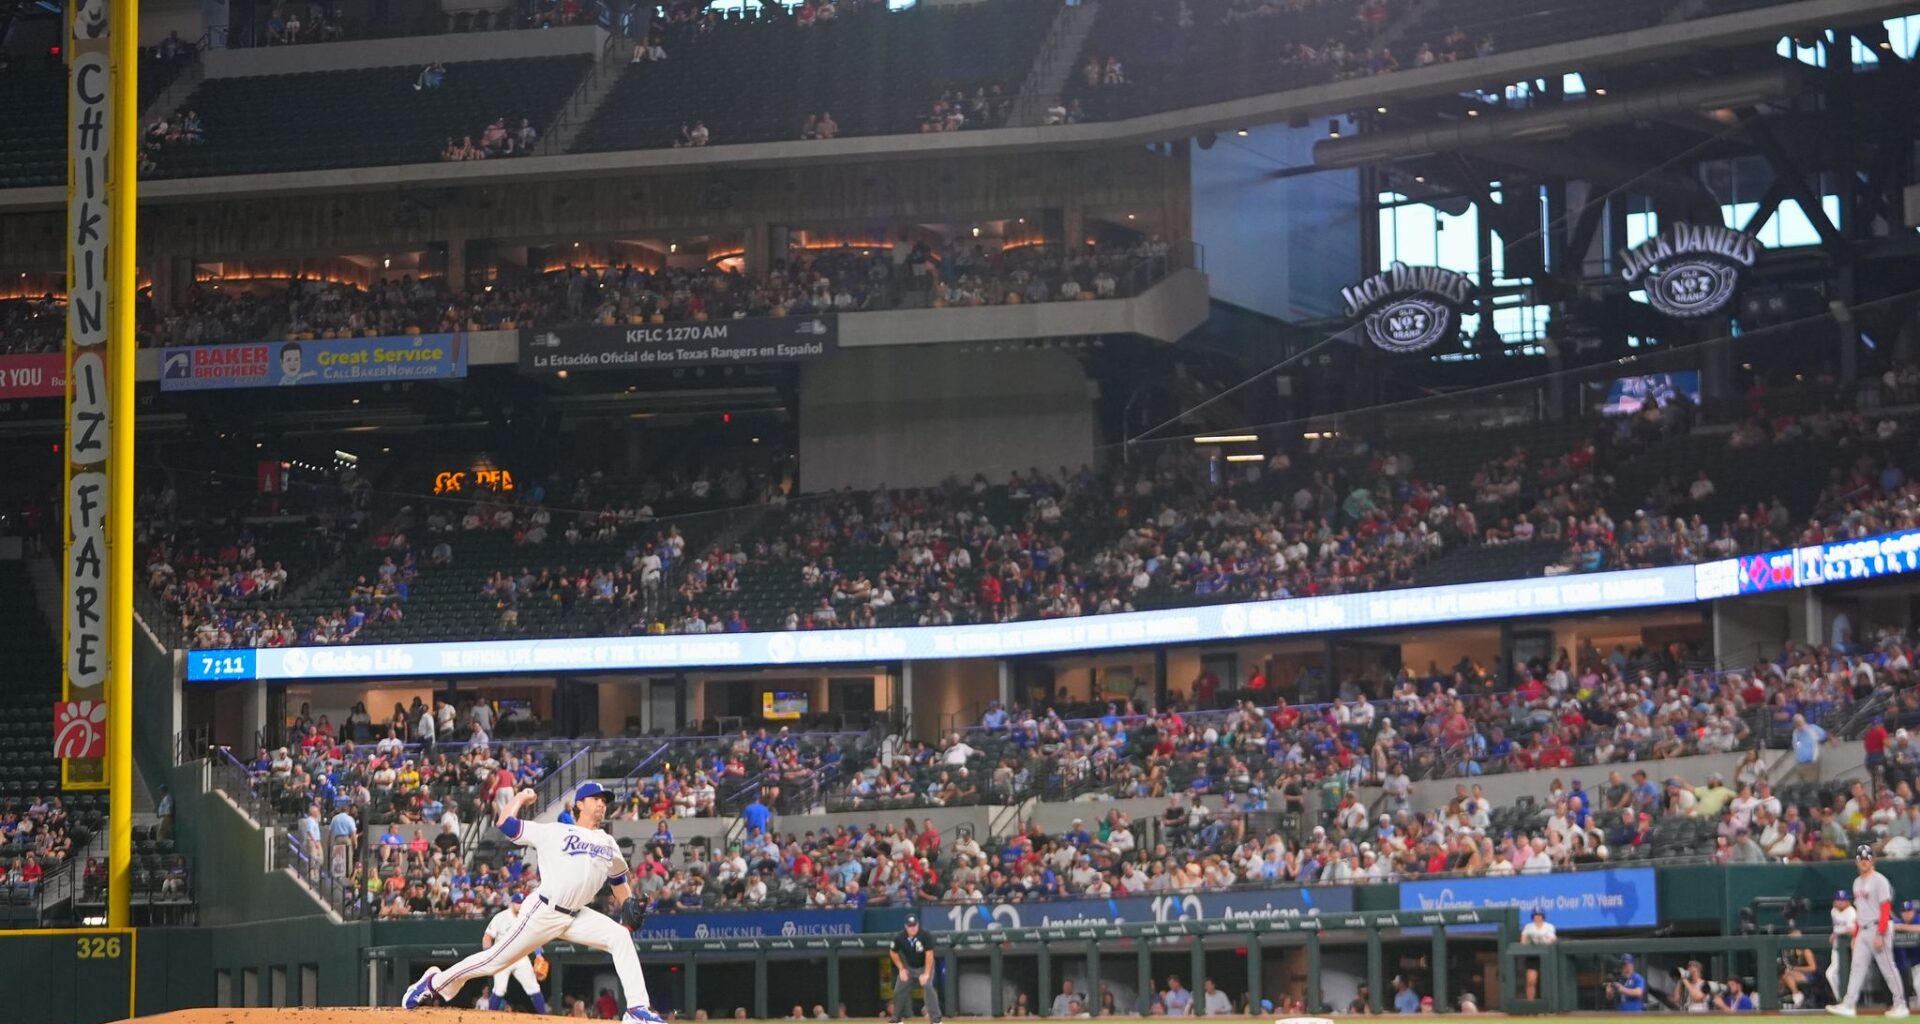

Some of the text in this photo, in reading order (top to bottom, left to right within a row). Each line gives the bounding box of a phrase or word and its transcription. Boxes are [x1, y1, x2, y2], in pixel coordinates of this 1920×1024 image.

[1620, 232, 1672, 281] JACK
[1341, 272, 1390, 318] JACK
[626, 325, 727, 344] KFLC 1270 AM
[195, 346, 269, 366] BAKER
[317, 347, 443, 366] Great Service
[534, 342, 823, 367] La Estación Oficial de los Texas Rangers en Español
[10, 367, 42, 387] YOU
[75, 63, 105, 675] CHIKIN IZ FARE
[194, 364, 268, 379] BROTHERS
[202, 657, 244, 674] 7:11
[311, 648, 413, 672] Globe Life
[1582, 893, 1594, 907] 70
[77, 937, 121, 959] 326
